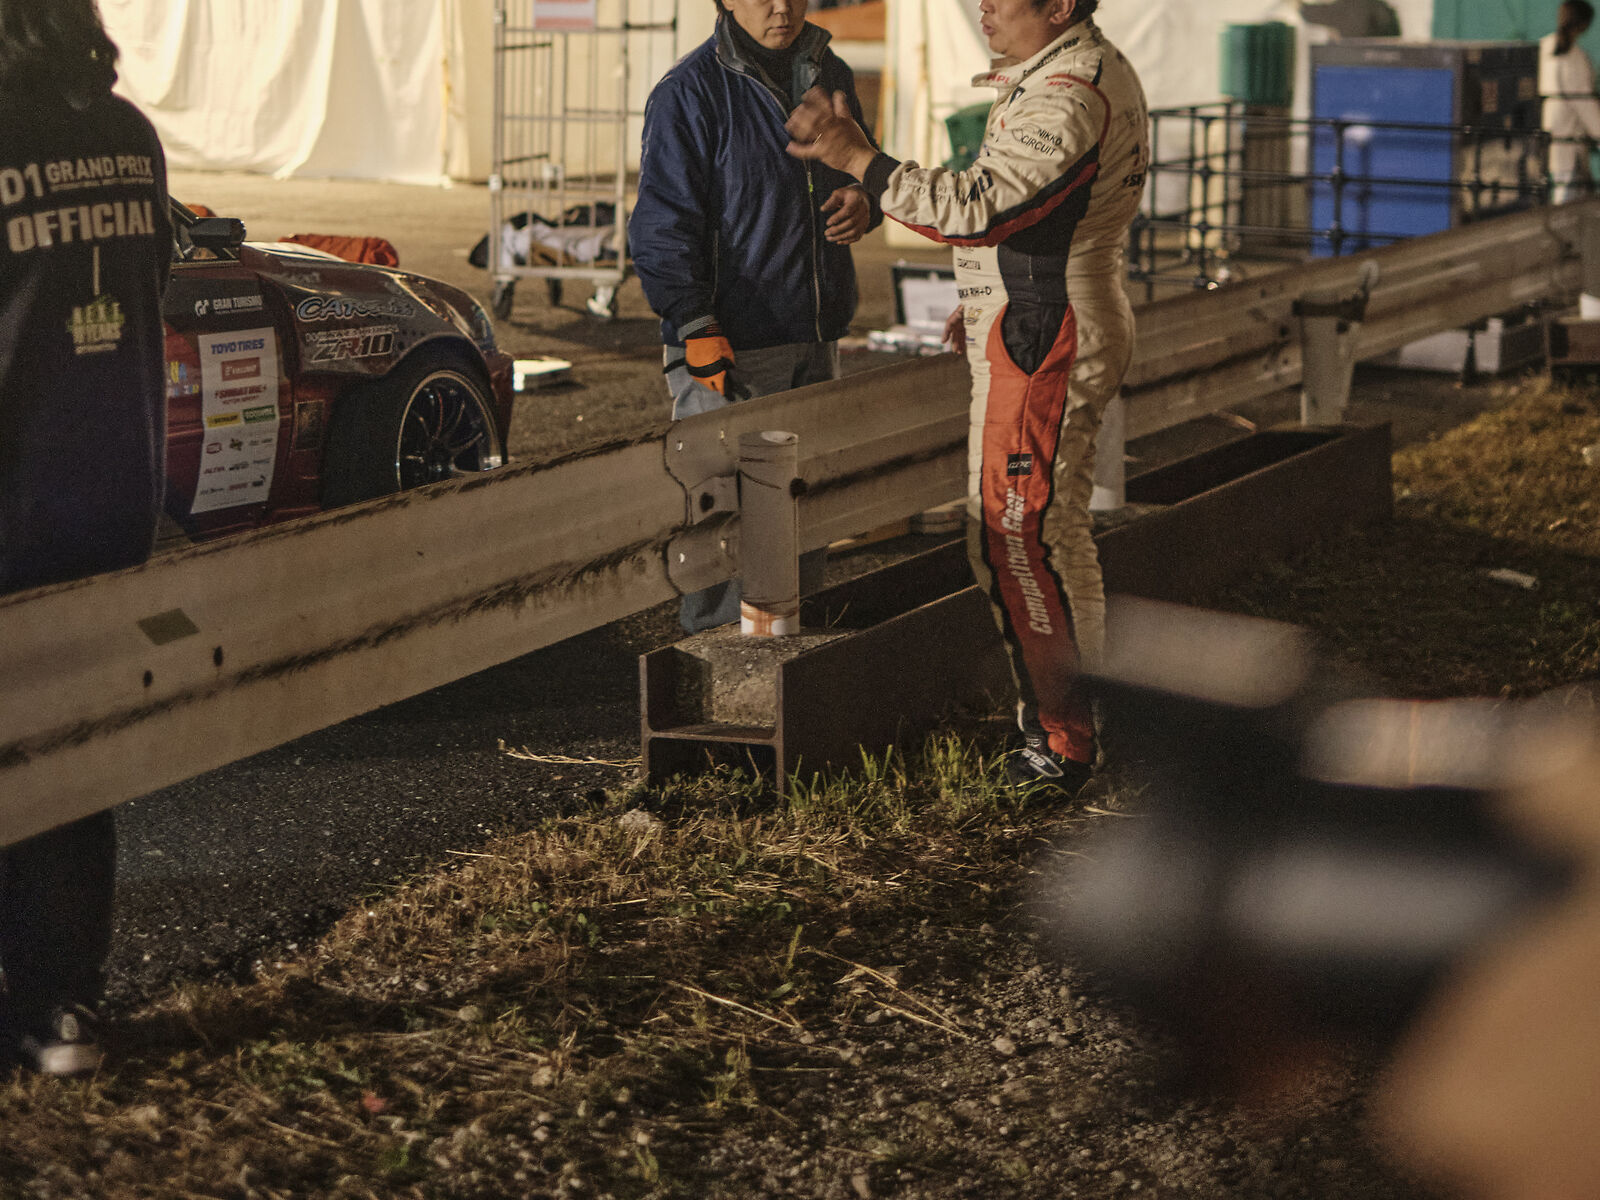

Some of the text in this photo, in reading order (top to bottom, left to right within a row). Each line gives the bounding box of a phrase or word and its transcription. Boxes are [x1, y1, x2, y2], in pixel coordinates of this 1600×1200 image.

[1020, 135, 1057, 157] CIRCUIT
[1038, 128, 1063, 146] NIKKO
[0, 158, 44, 206] D1
[45, 156, 116, 185] GRAND
[115, 155, 153, 177] PRIX
[7, 200, 155, 254] OFFICIAL
[211, 338, 265, 355] TOYO TIRES
[1006, 533, 1054, 636] Competition
